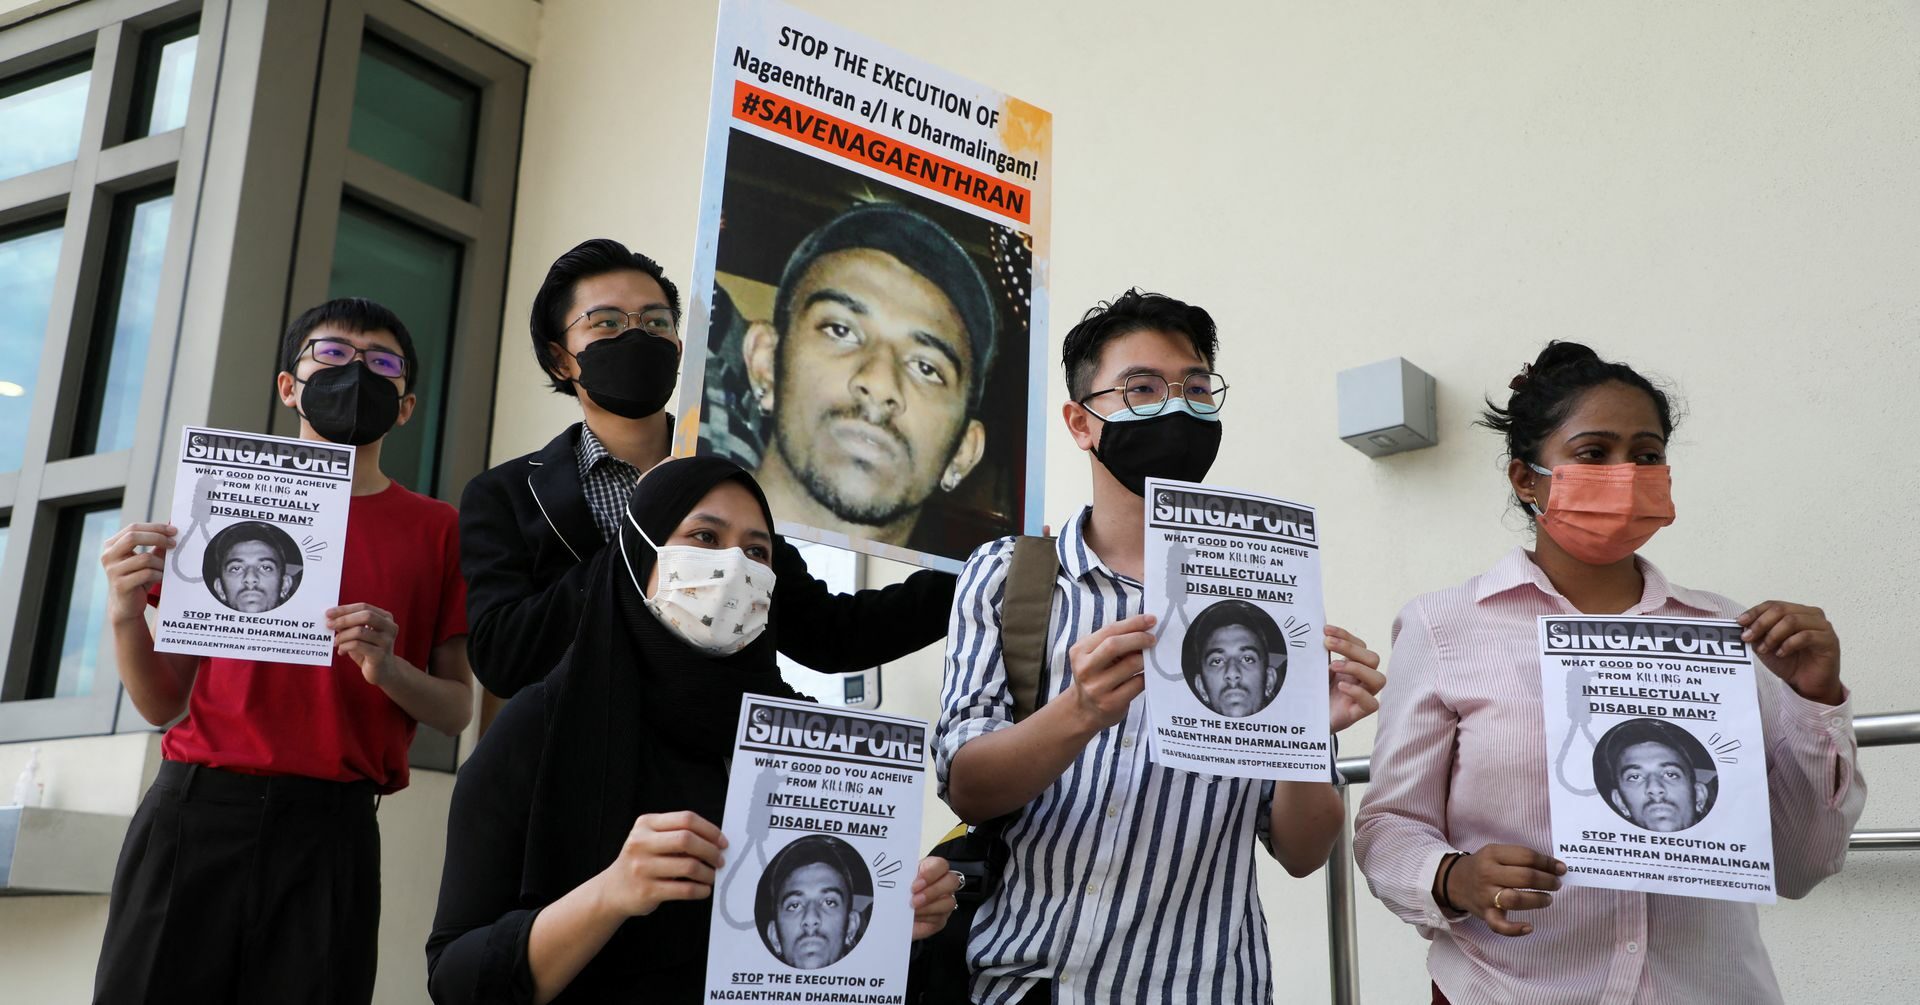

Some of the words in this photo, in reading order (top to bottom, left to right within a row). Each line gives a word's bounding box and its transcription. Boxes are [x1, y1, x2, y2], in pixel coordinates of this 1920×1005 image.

[779, 27, 828, 59] STOP
[834, 47, 868, 79] THE
[873, 64, 972, 119] EXECUTION
[977, 106, 999, 129] OF
[733, 47, 855, 111] Nagaenthran
[893, 108, 902, 130] K
[909, 115, 1038, 180] Dharmalingam!
[742, 93, 1024, 214] #SAVENAGAENTHRAN
[188, 435, 348, 473] SINGAPORE
[223, 481, 250, 489] FROM
[255, 483, 291, 495] KILLING
[226, 471, 254, 479] GOOD
[274, 476, 293, 484] YOU
[297, 479, 337, 489] ACHEIVE
[208, 491, 320, 511] INTELLECTUALLY
[211, 506, 274, 520] DISABLED
[278, 514, 313, 525] MAN?
[1155, 492, 1314, 539] SINGAPORE
[1164, 534, 1194, 543] WHAT
[1198, 537, 1227, 547] GOOD
[1247, 543, 1267, 551] YOU
[1270, 546, 1308, 558] ACHEIVE
[1196, 551, 1224, 560] FROM
[1229, 552, 1266, 564] KILLING
[1181, 564, 1297, 584] INTELLECTUALLY
[1186, 582, 1252, 597] DISABLED
[1257, 589, 1293, 601] MAN?
[182, 611, 211, 619] STOP
[239, 616, 299, 628] EXECUTION
[302, 621, 315, 629] OF
[163, 621, 244, 634] NAGAENTHRAN
[248, 628, 331, 641] DHARMALINGAM
[1550, 623, 1744, 656] SINGAPORE
[161, 638, 245, 650] #SAVENAGAENTHRAN
[247, 646, 329, 657] #STOPTHEEXECUTION
[1599, 661, 1633, 669] GOOD
[1657, 663, 1681, 671] YOU
[1685, 665, 1736, 674] ACHEIVE
[1637, 673, 1681, 684] KILLING
[1582, 686, 1720, 702] INTELLECTUALLY
[1590, 703, 1667, 716] DISABLED
[1673, 709, 1716, 719] MAN?
[749, 708, 923, 761] SINGAPORE
[1171, 716, 1198, 727] STOP
[1200, 720, 1221, 728] THE
[1225, 722, 1287, 733] EXECUTION
[1291, 727, 1306, 735] OF
[1158, 727, 1232, 744] NAGAENTHRAN
[1235, 737, 1326, 750] DHARMALINGAM
[1162, 749, 1235, 764] #SAVENAGAENTHRAN
[1238, 759, 1326, 770] #STOPTHEEXECUTION
[755, 758, 788, 769] WHAT
[791, 762, 822, 772] GOOD
[825, 766, 840, 775] DO
[844, 768, 867, 778] YOU
[871, 772, 913, 784] ACHEIVE
[787, 778, 816, 788] FROM
[822, 779, 863, 794] KILLING
[868, 787, 883, 795] AN
[768, 793, 896, 816] INTELLECTUALLY
[770, 815, 842, 832] DISABLED
[847, 824, 888, 836] MAN?
[1582, 831, 1616, 841] STOP
[1620, 834, 1646, 843] THE
[1651, 836, 1725, 851] EXECUTION
[1730, 844, 1747, 852] OF
[1560, 844, 1660, 859] NAGAENTHRAN
[1665, 853, 1770, 871] DHARMALINGAM
[1567, 866, 1664, 881] SAVENAGAENTHRAN
[1667, 875, 1771, 891] #STOPTHEEXECUTION
[731, 973, 764, 983] STOP
[768, 974, 791, 983] THE
[795, 976, 865, 987] EXECUTION
[870, 979, 885, 987] OF
[710, 990, 801, 1001] NAGAENTHRAN
[805, 993, 902, 1004] DHARMALINGAM
